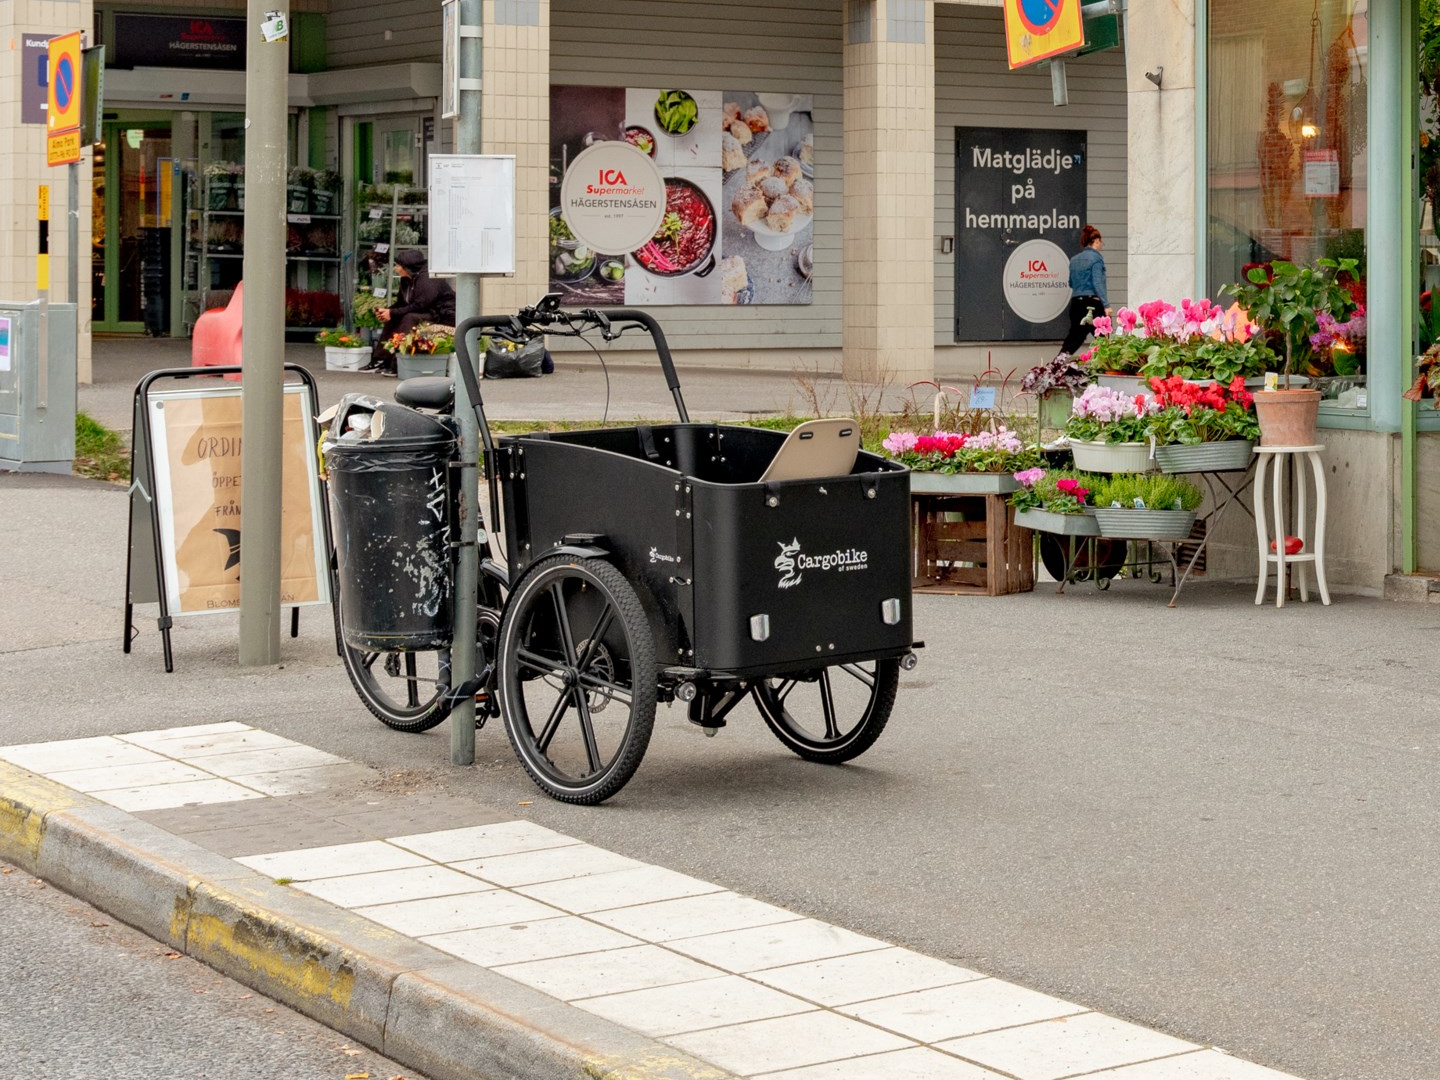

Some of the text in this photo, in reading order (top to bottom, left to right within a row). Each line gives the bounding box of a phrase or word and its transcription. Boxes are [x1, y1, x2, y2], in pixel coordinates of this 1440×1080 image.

[973, 148, 1073, 174] Matglädje
[599, 169, 628, 186] ICA
[586, 184, 645, 196] Supermarket
[1011, 178, 1036, 204] på
[570, 197, 657, 209] HÄGERSTENSÅSEN
[965, 208, 1080, 234] hemmaplan
[1028, 260, 1048, 272] ICA
[1009, 281, 1068, 289] HÄGERSTENSÅSEN
[797, 548, 868, 570] Cargobike
